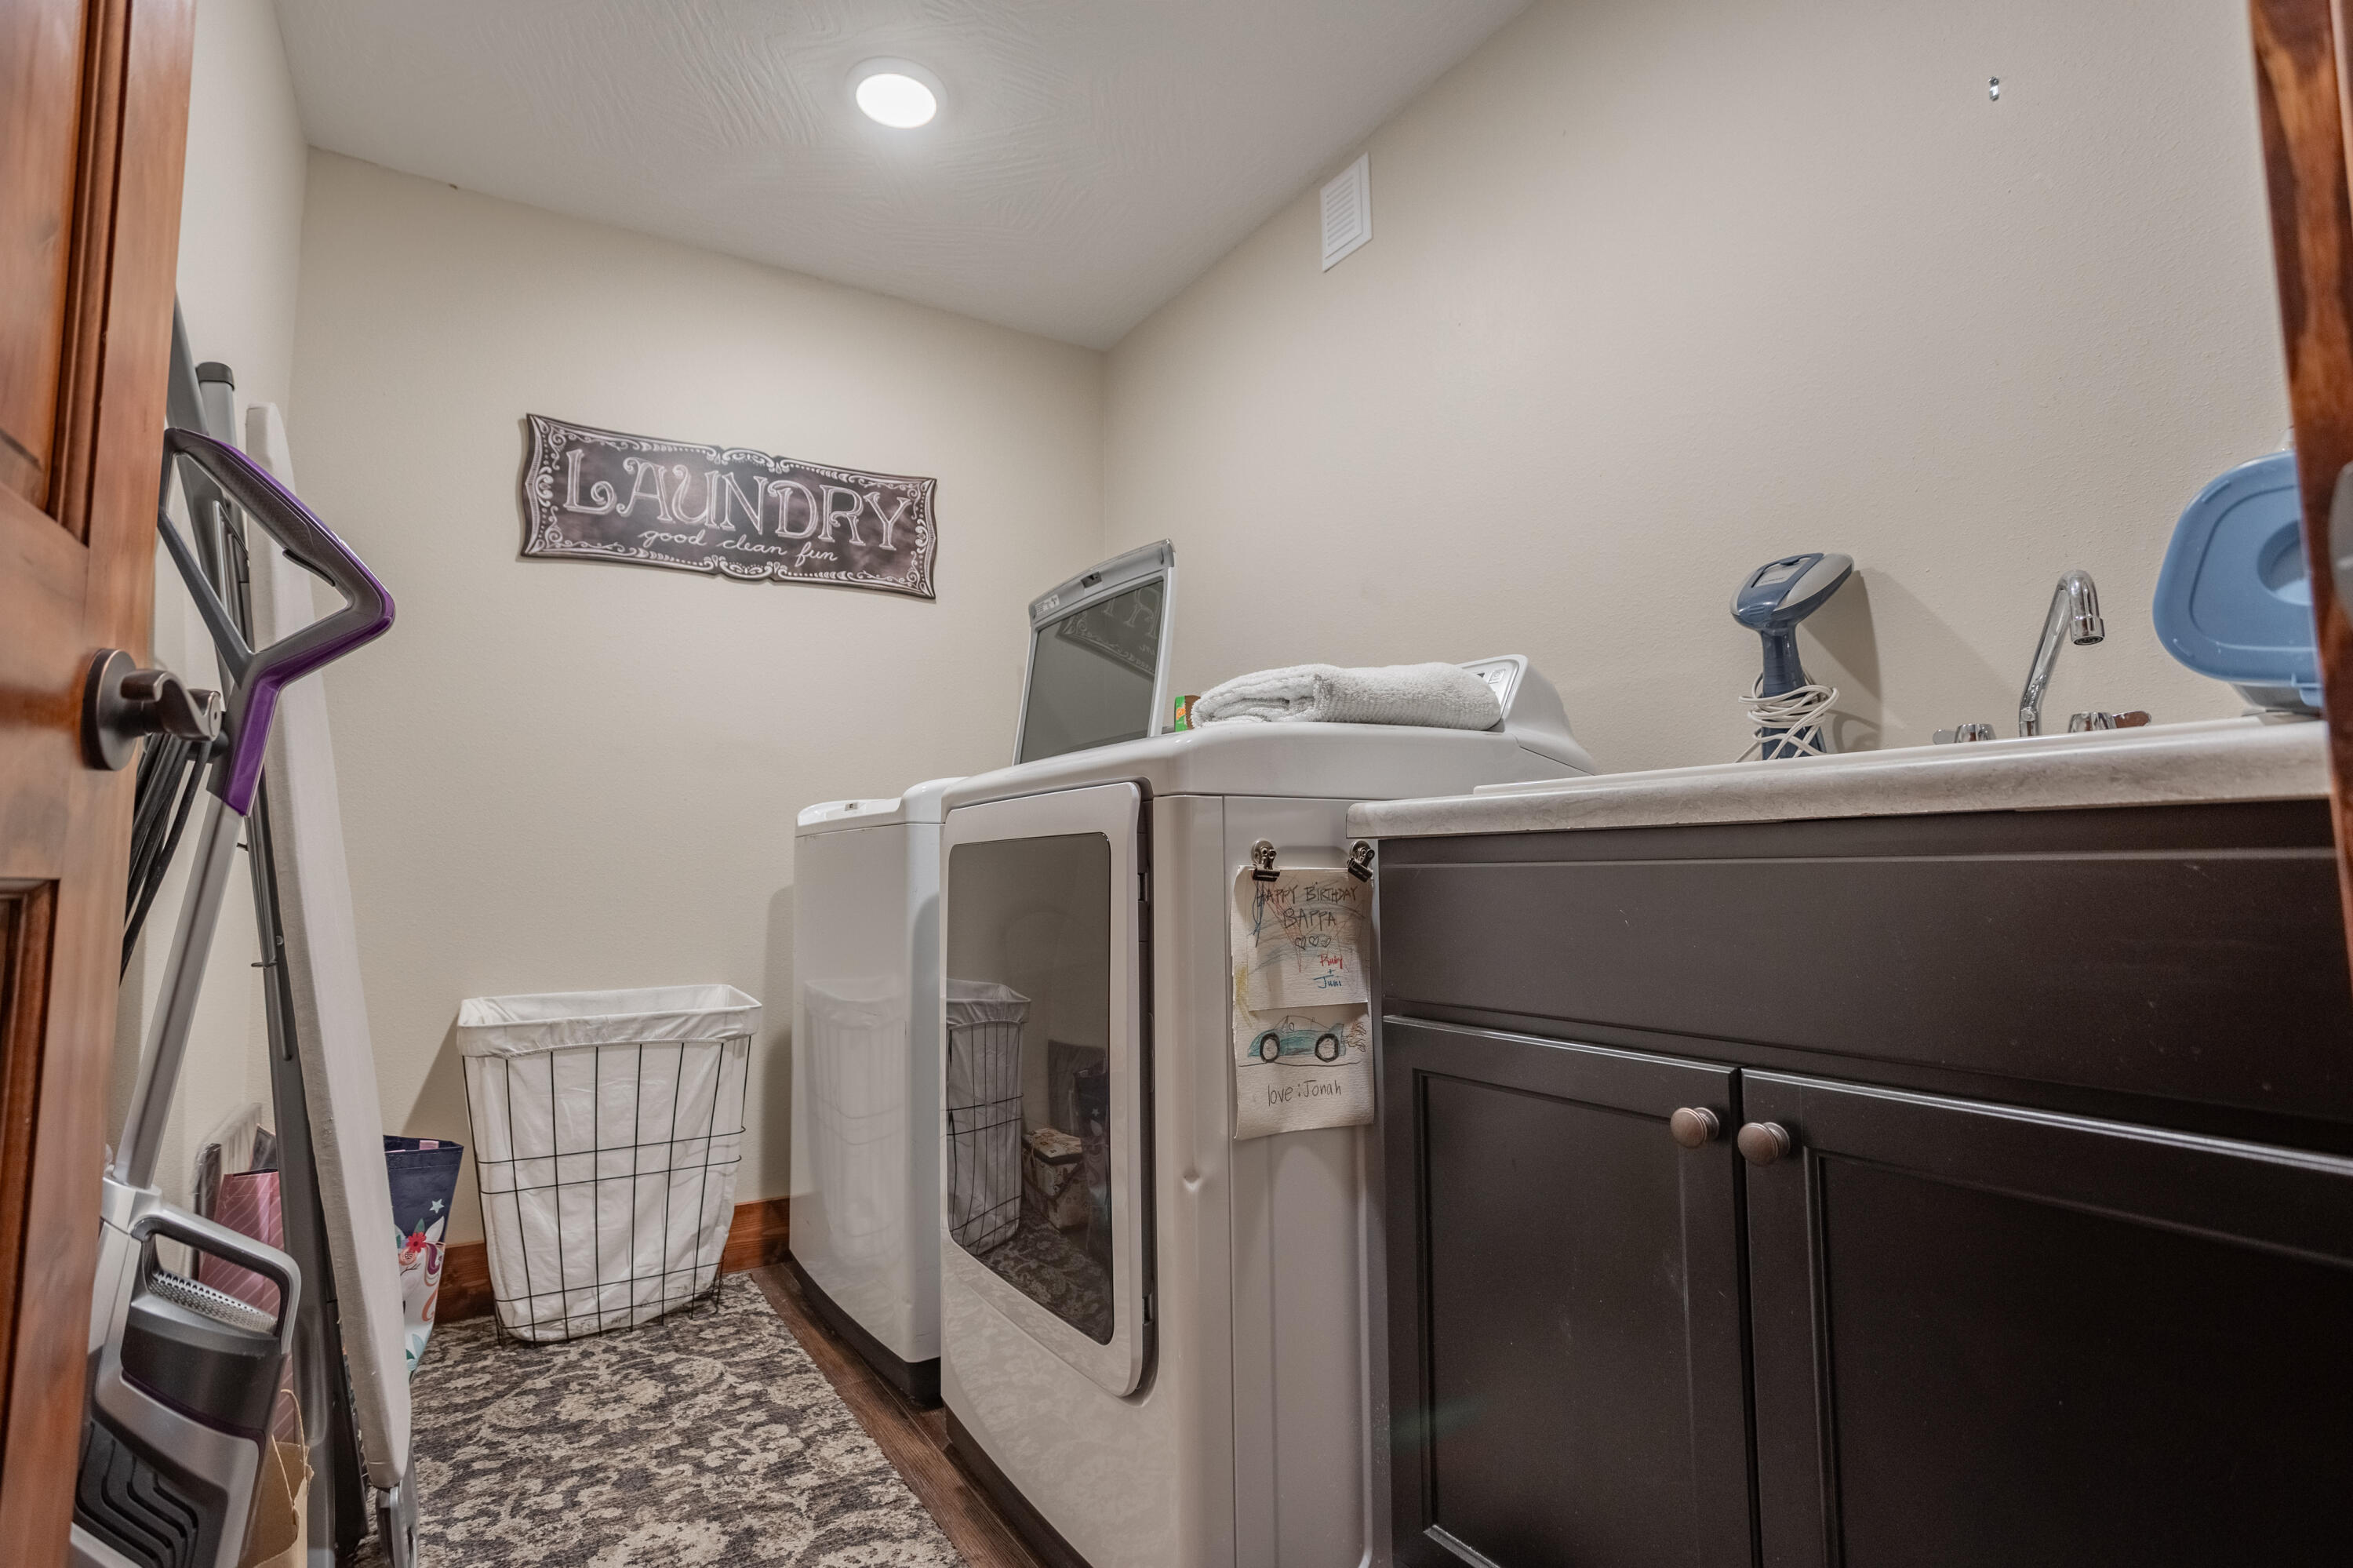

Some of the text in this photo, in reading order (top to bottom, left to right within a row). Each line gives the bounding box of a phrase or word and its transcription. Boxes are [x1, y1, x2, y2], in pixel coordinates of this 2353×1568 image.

[563, 448, 911, 550] LAUNDRY
[638, 529, 838, 567] good clean fun
[1257, 882, 1358, 904] HAPPY BIRTHDAY
[1282, 908, 1337, 931] BAPPA
[1303, 1079, 1342, 1097] Jonah
